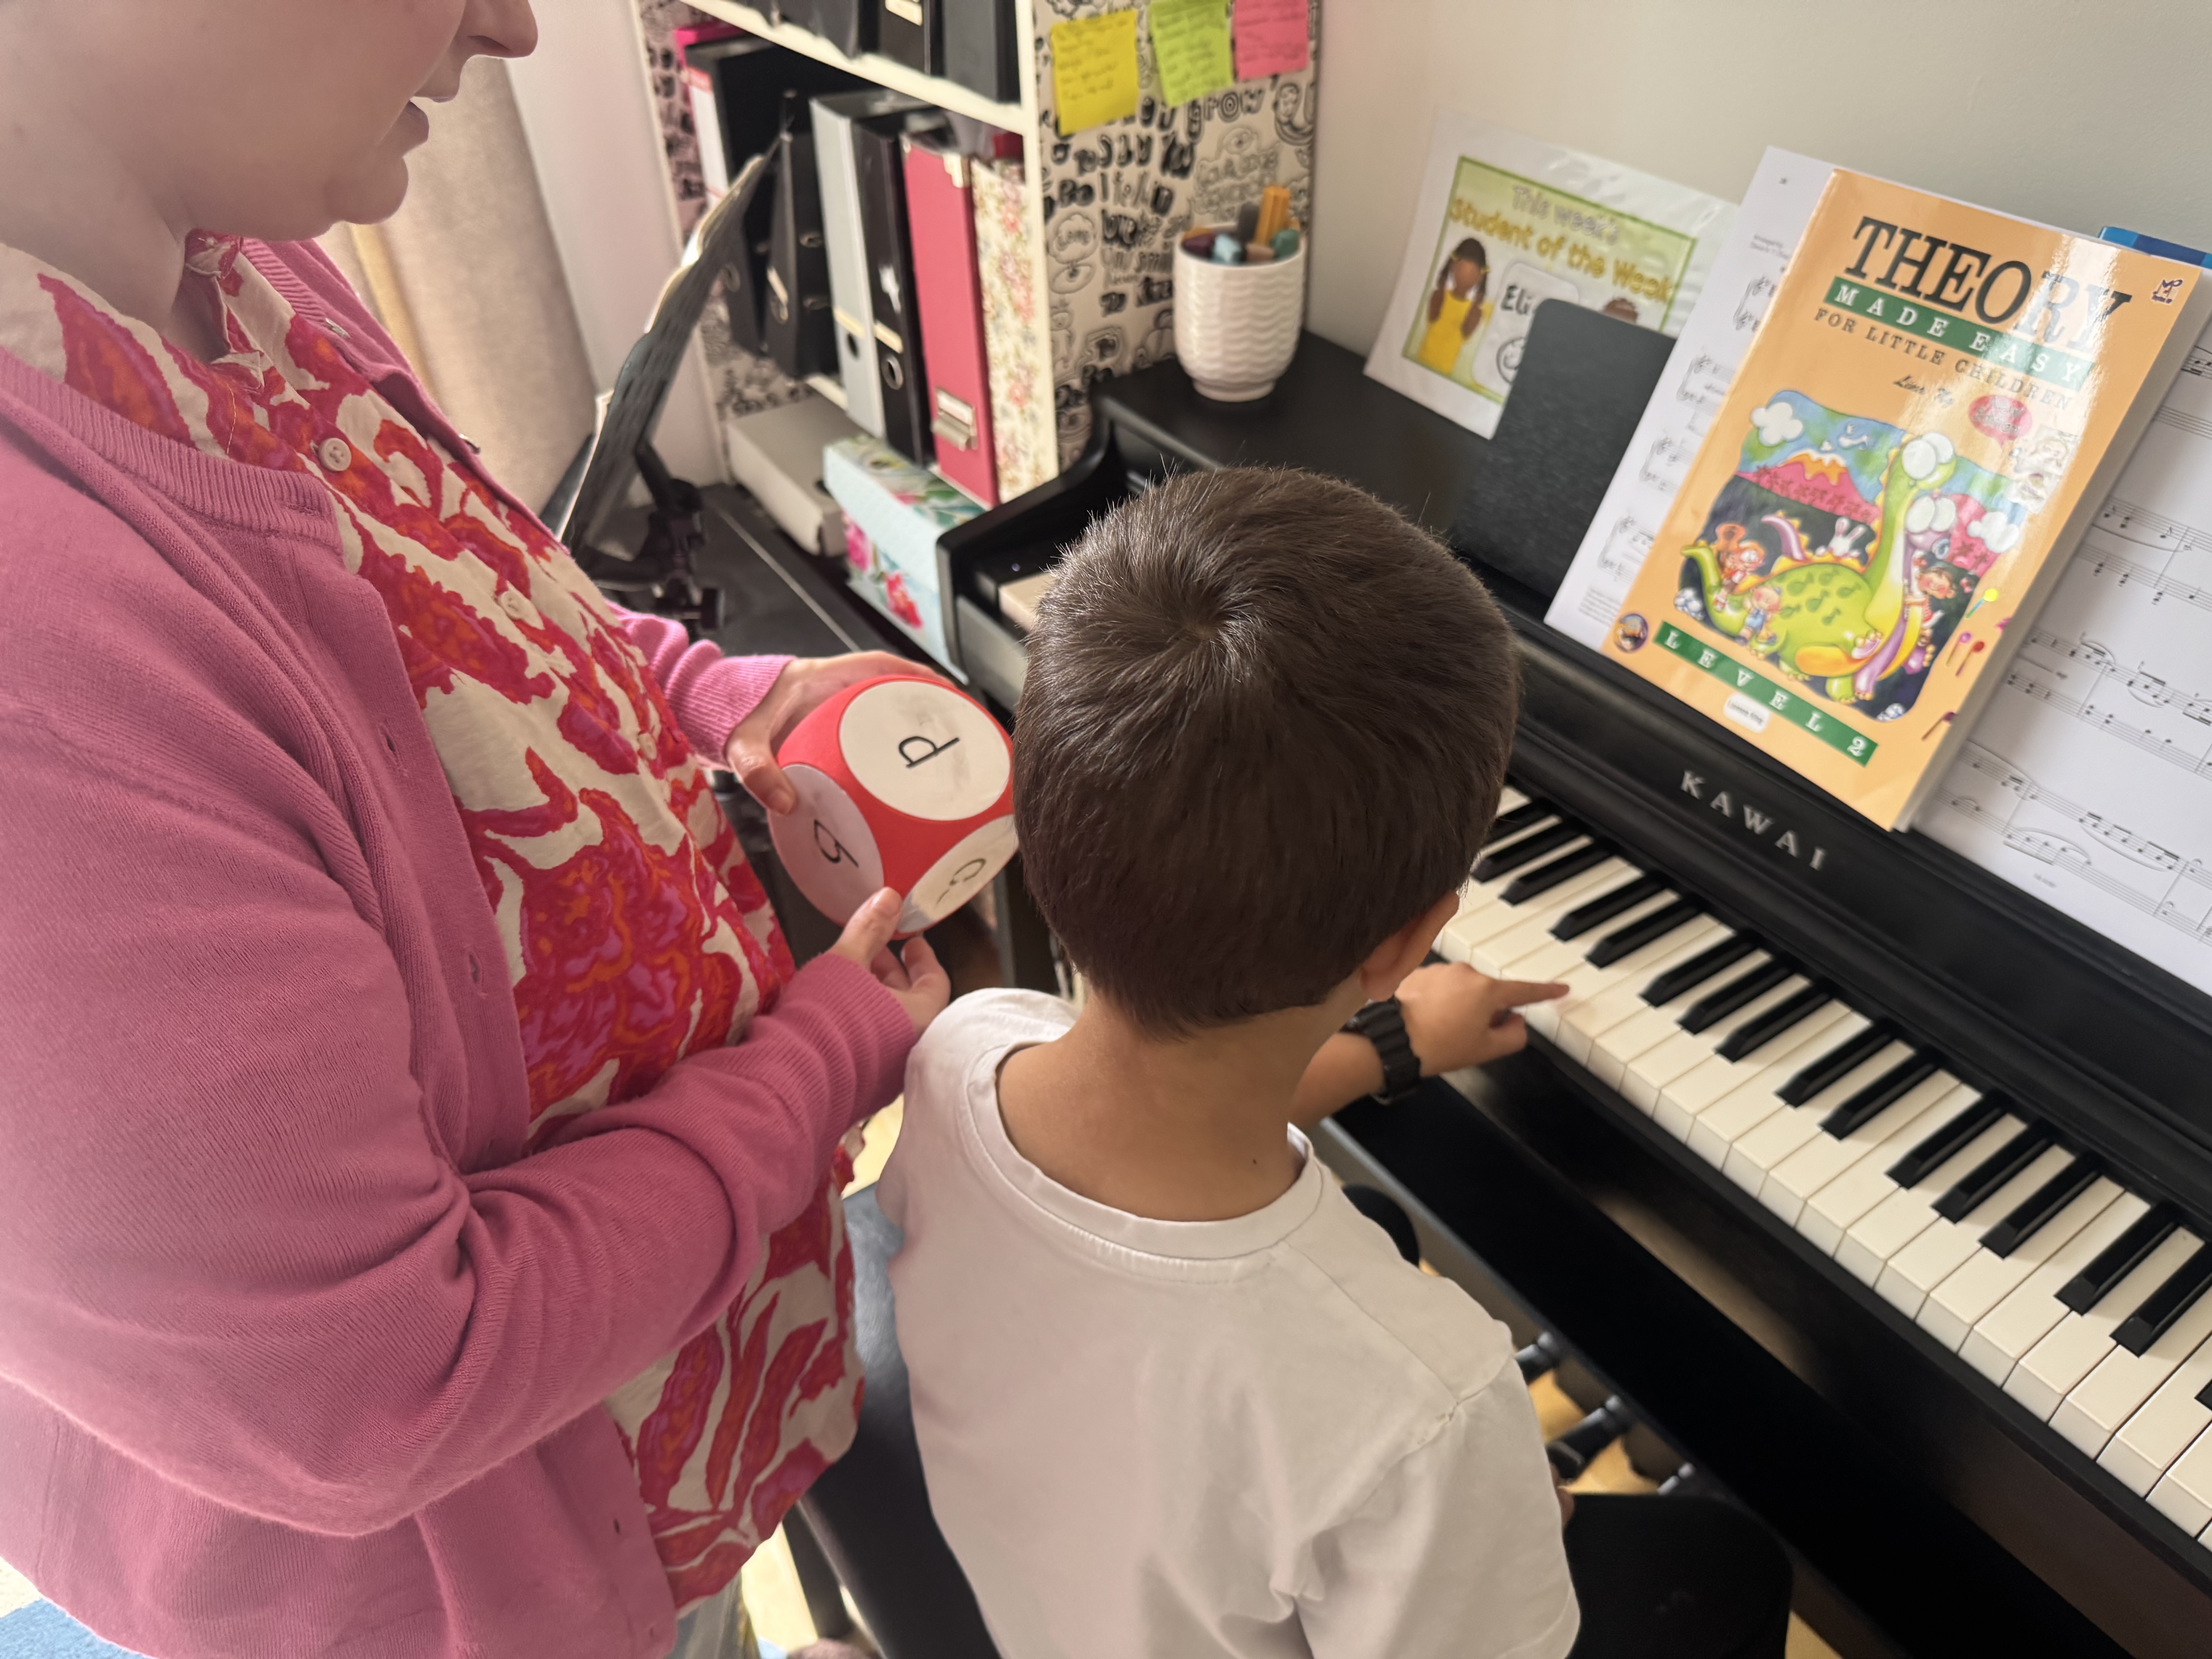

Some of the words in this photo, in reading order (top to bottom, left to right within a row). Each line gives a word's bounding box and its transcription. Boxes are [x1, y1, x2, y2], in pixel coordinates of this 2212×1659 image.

[1450, 198, 1533, 249] Student
[1536, 235, 1565, 260] of
[1568, 243, 1605, 278] the
[1612, 259, 1673, 304] Week
[1513, 187, 1549, 218] This
[1554, 204, 1619, 244] week's
[1501, 285, 1537, 316] Eli
[1834, 284, 1949, 338] MADE
[1969, 333, 2083, 385] EASY
[1845, 216, 2132, 354] THEORY
[1814, 308, 1857, 334] FOR
[1866, 326, 1945, 366] LITTLE
[1955, 358, 2075, 411] CHILDREN
[1664, 630, 1821, 733] LEVEL
[1847, 736, 1865, 757] 2
[1680, 770, 1829, 871] KAWAI
